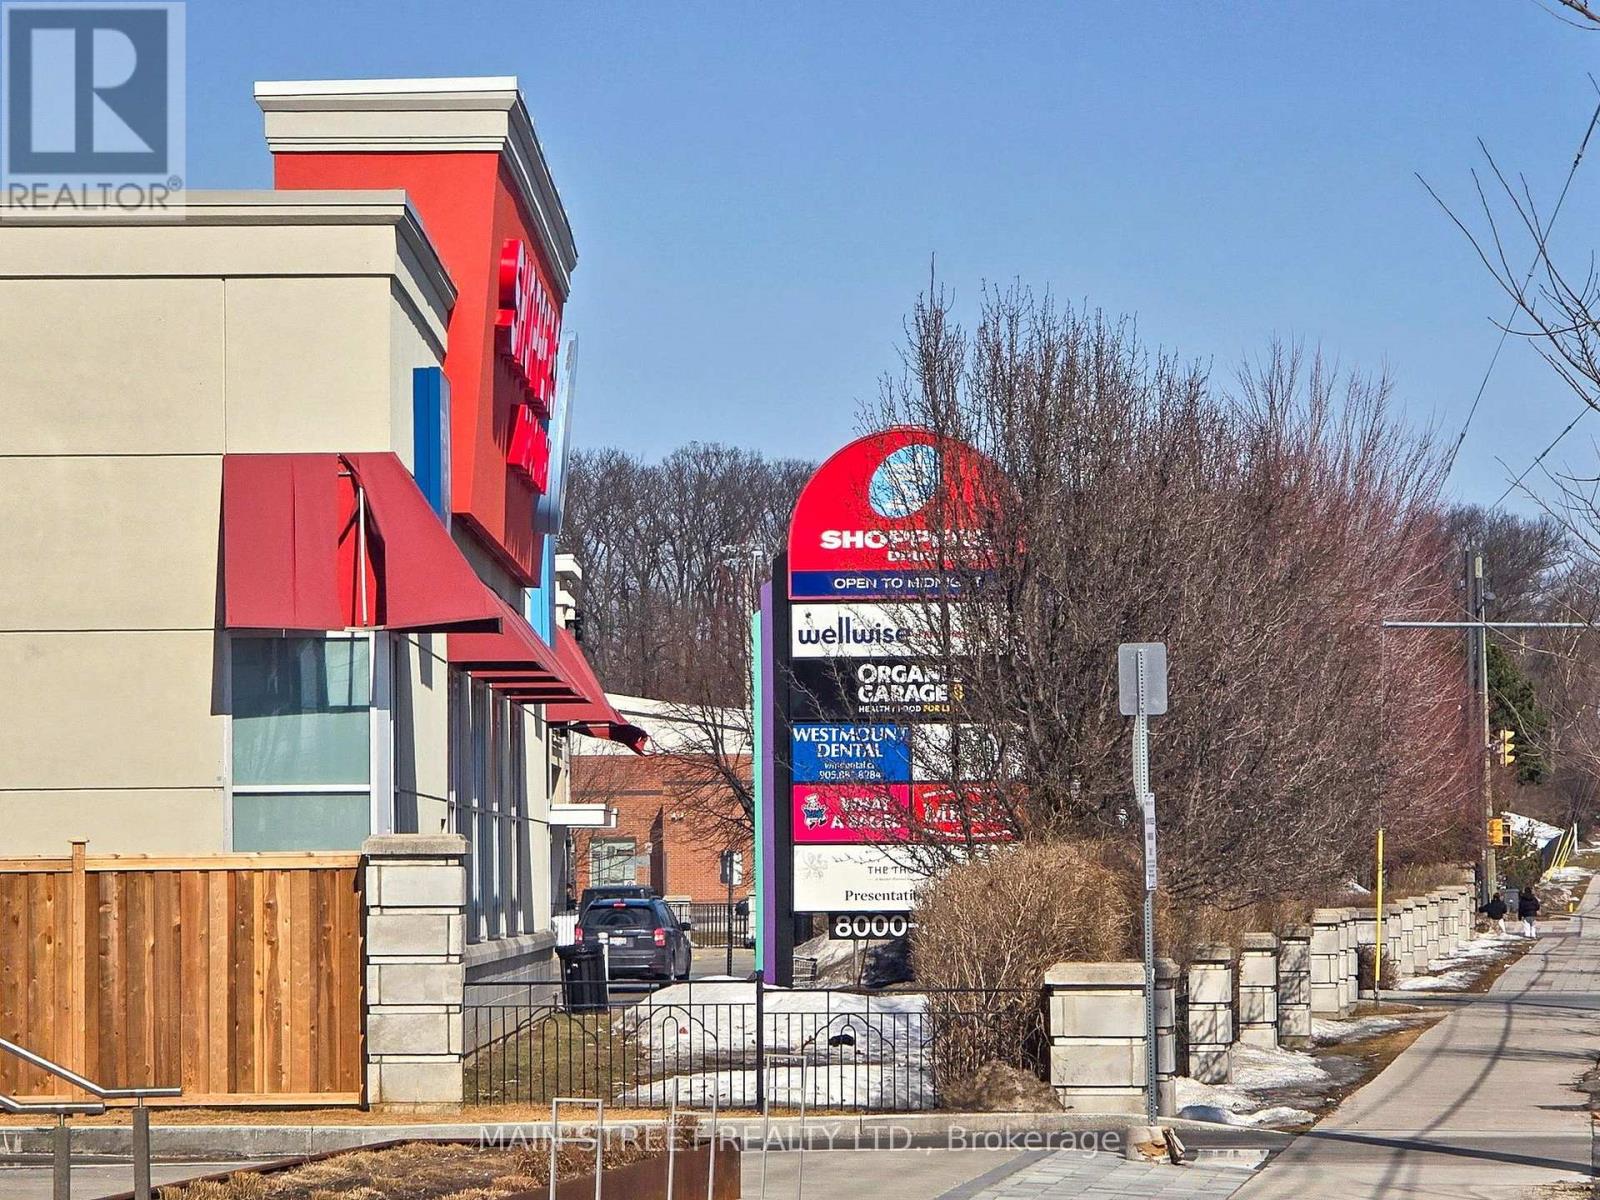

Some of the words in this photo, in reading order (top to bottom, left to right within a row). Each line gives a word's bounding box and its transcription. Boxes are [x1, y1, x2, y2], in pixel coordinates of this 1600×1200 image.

[819, 530, 992, 550] SHOPP
[833, 577, 877, 589] OPEN
[881, 577, 903, 588] TO
[798, 616, 910, 645] wellwise
[857, 684, 949, 703] GARAGE
[922, 704, 940, 712] FOR
[817, 743, 883, 758] DENTAL
[830, 815, 845, 829] A
[867, 865, 889, 875] THE
[845, 889, 920, 902] Presentati
[834, 914, 920, 938] 8000-
